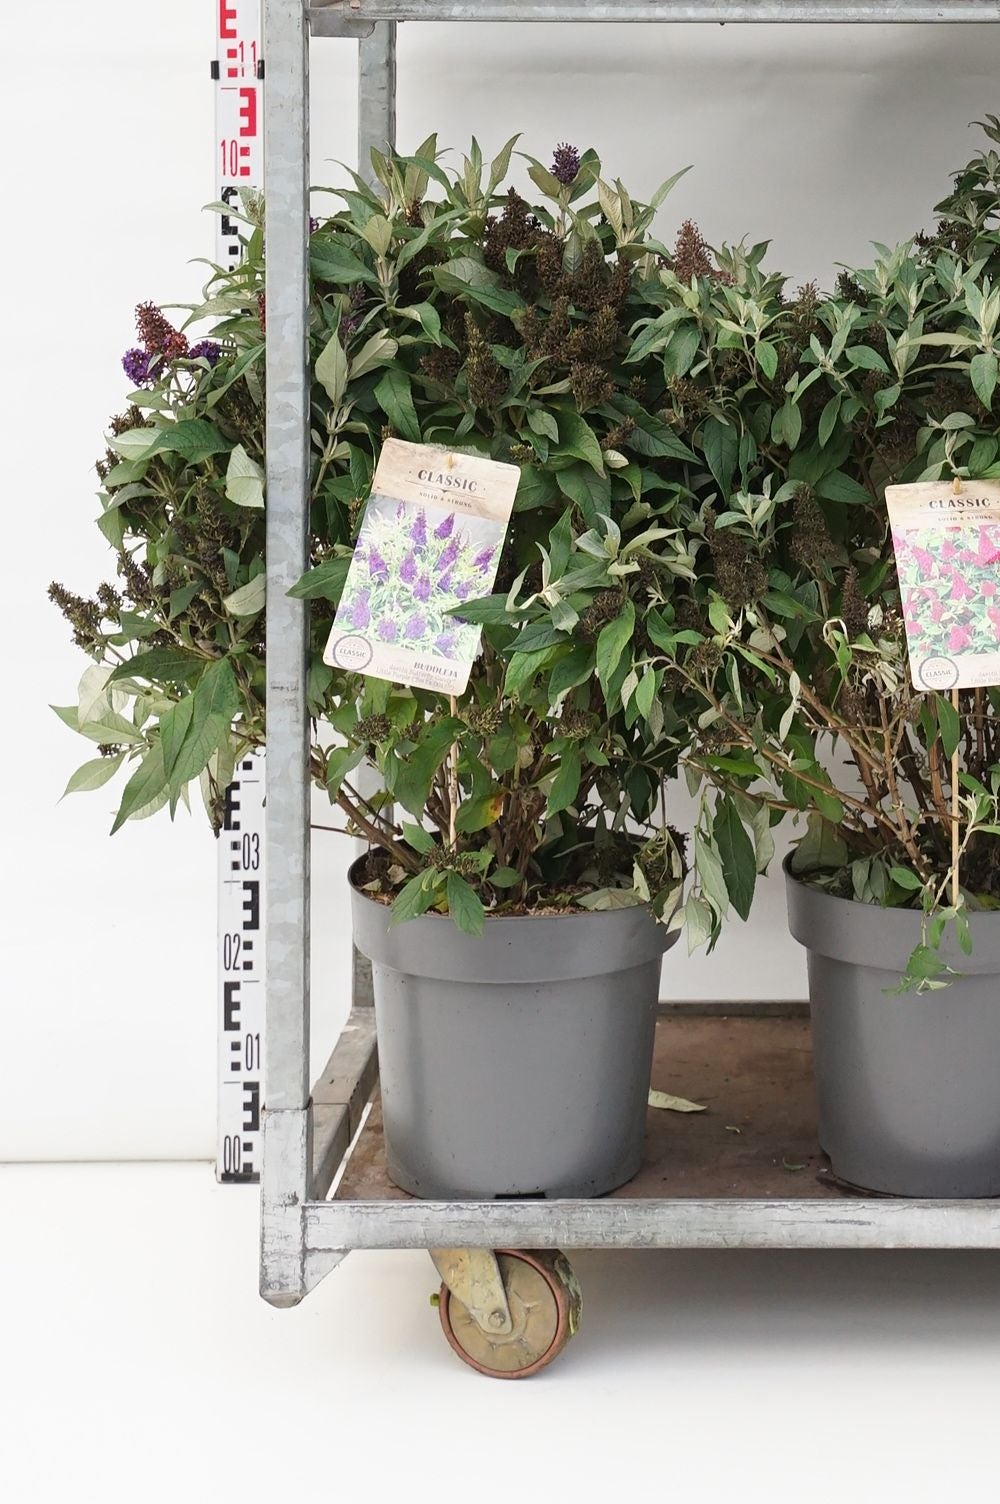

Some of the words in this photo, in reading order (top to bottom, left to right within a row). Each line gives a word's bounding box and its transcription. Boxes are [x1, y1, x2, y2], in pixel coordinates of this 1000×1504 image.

[239, 41, 257, 78] 11
[220, 139, 238, 177] 10
[417, 469, 478, 493] CLASSIC
[929, 497, 991, 509] CLASSIC
[339, 648, 366, 657] CLASSIC
[414, 661, 458, 678] BUDDLEJA
[925, 669, 952, 678] CLASSIC
[242, 832, 260, 871] 03
[223, 933, 241, 971] 02
[245, 1033, 261, 1072] 01
[223, 1135, 241, 1173] 00
